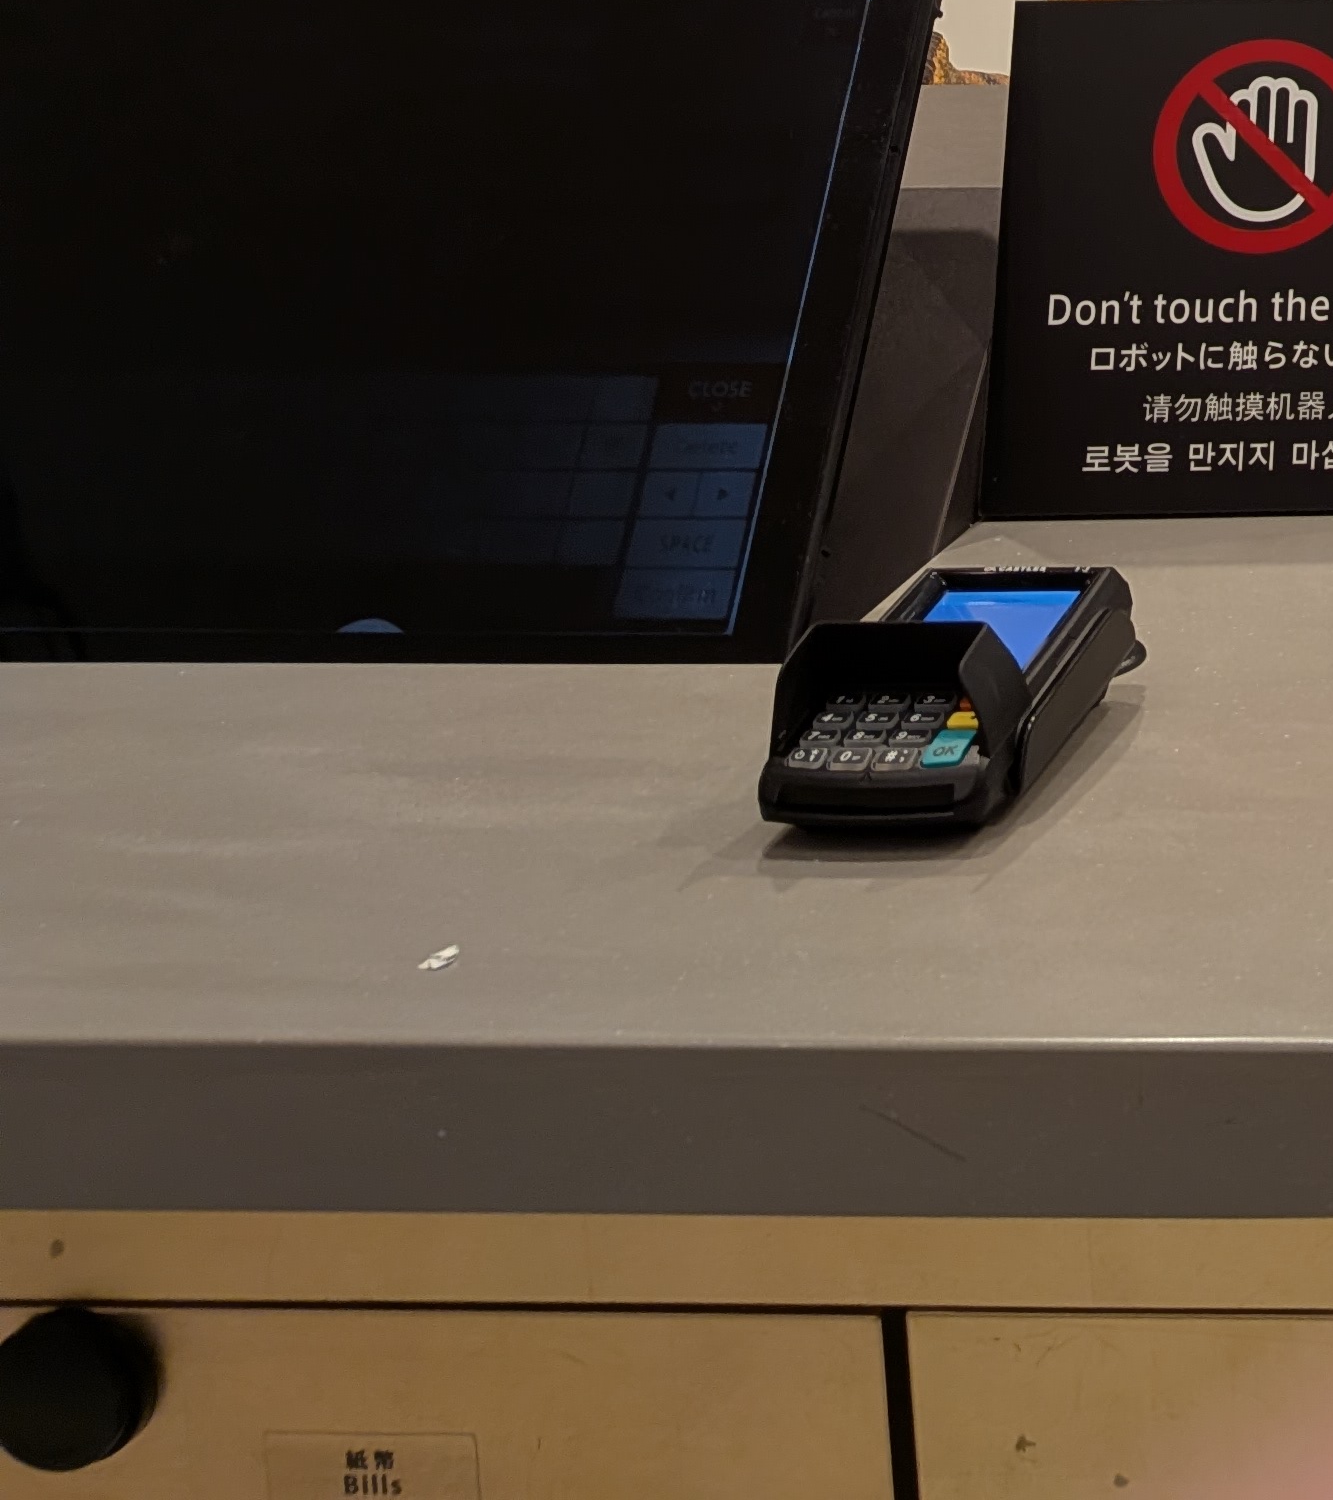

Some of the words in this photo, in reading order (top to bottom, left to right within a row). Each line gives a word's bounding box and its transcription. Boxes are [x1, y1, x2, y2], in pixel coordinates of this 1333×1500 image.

[1048, 291, 1142, 325] Don't
[1154, 290, 1256, 324] touch
[1271, 289, 1329, 321] the
[1082, 443, 1173, 473] 로봇을
[1189, 441, 1275, 471] 만지지
[932, 745, 955, 756] OK
[344, 1474, 402, 1495] Bills
